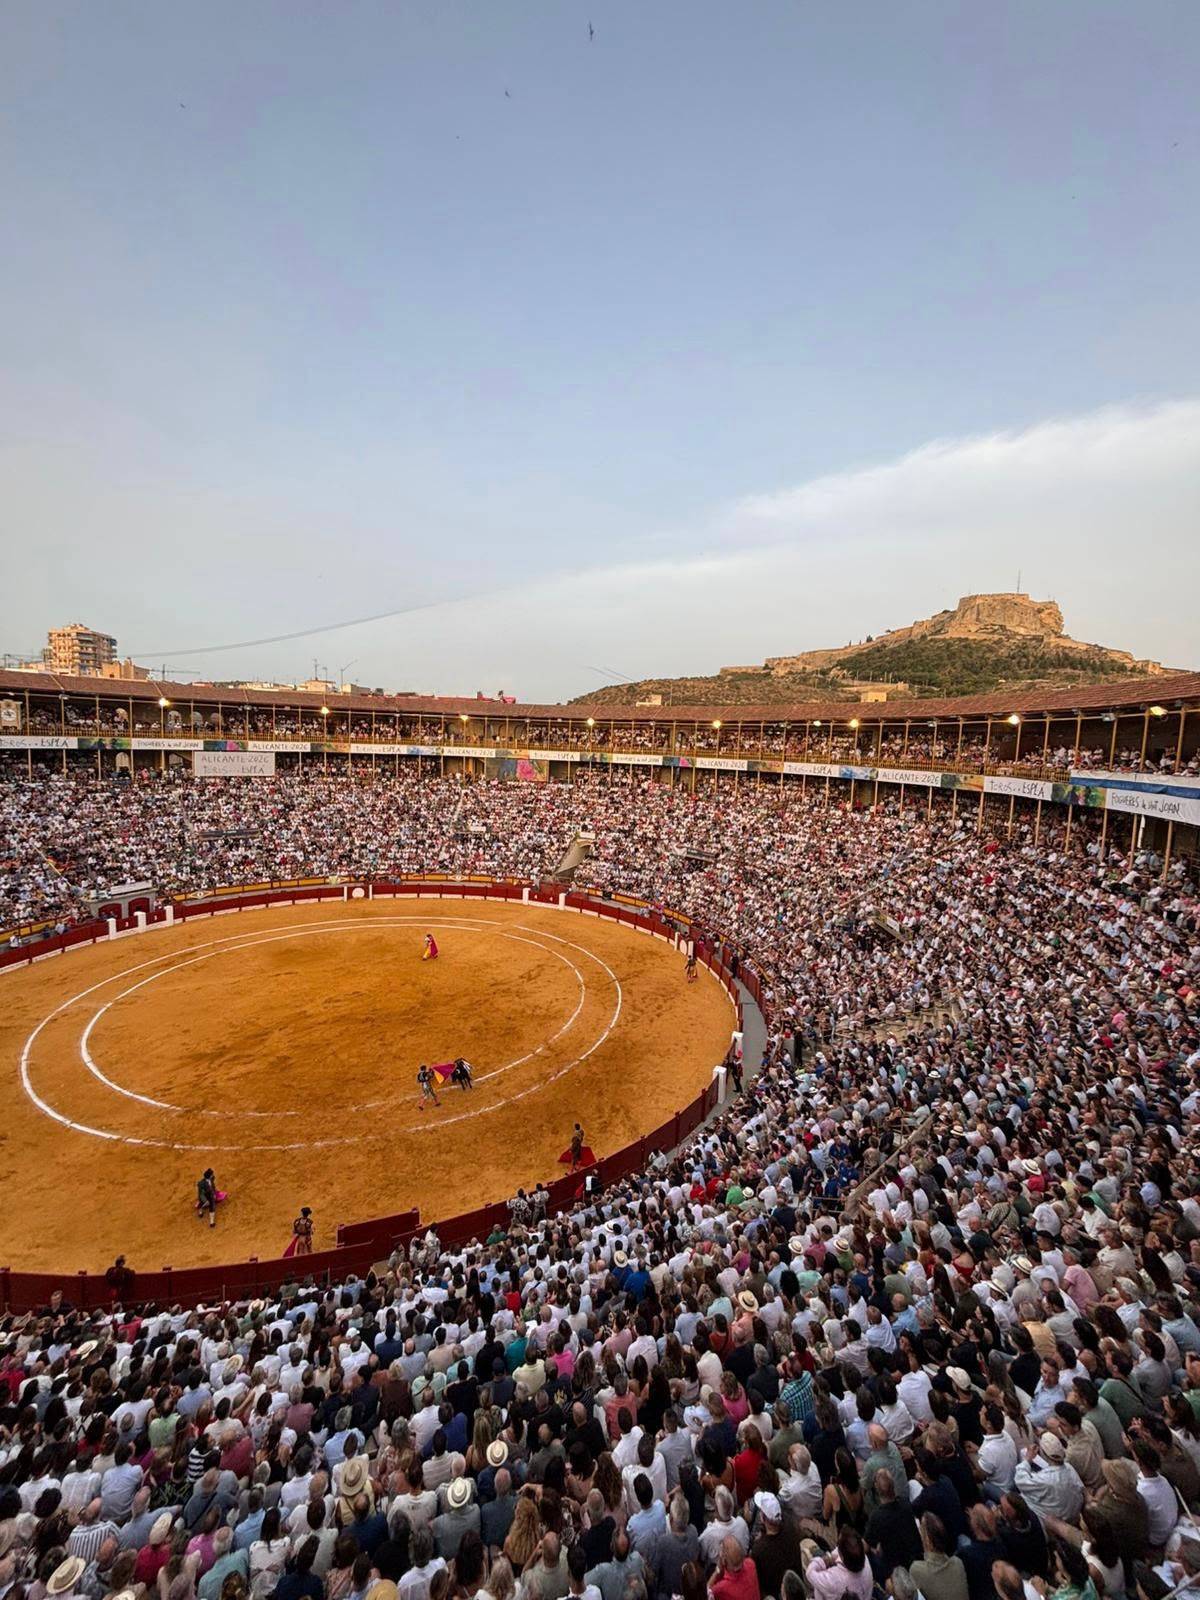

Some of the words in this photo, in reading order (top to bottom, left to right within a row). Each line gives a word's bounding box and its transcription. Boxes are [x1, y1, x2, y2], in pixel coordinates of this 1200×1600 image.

[252, 743, 289, 751] ALICANTE
[200, 754, 246, 763] ALICANTE
[247, 754, 269, 763] 2026
[882, 771, 920, 784] ALICANTE
[920, 774, 940, 786] 2026
[1159, 798, 1181, 815] JOAN
